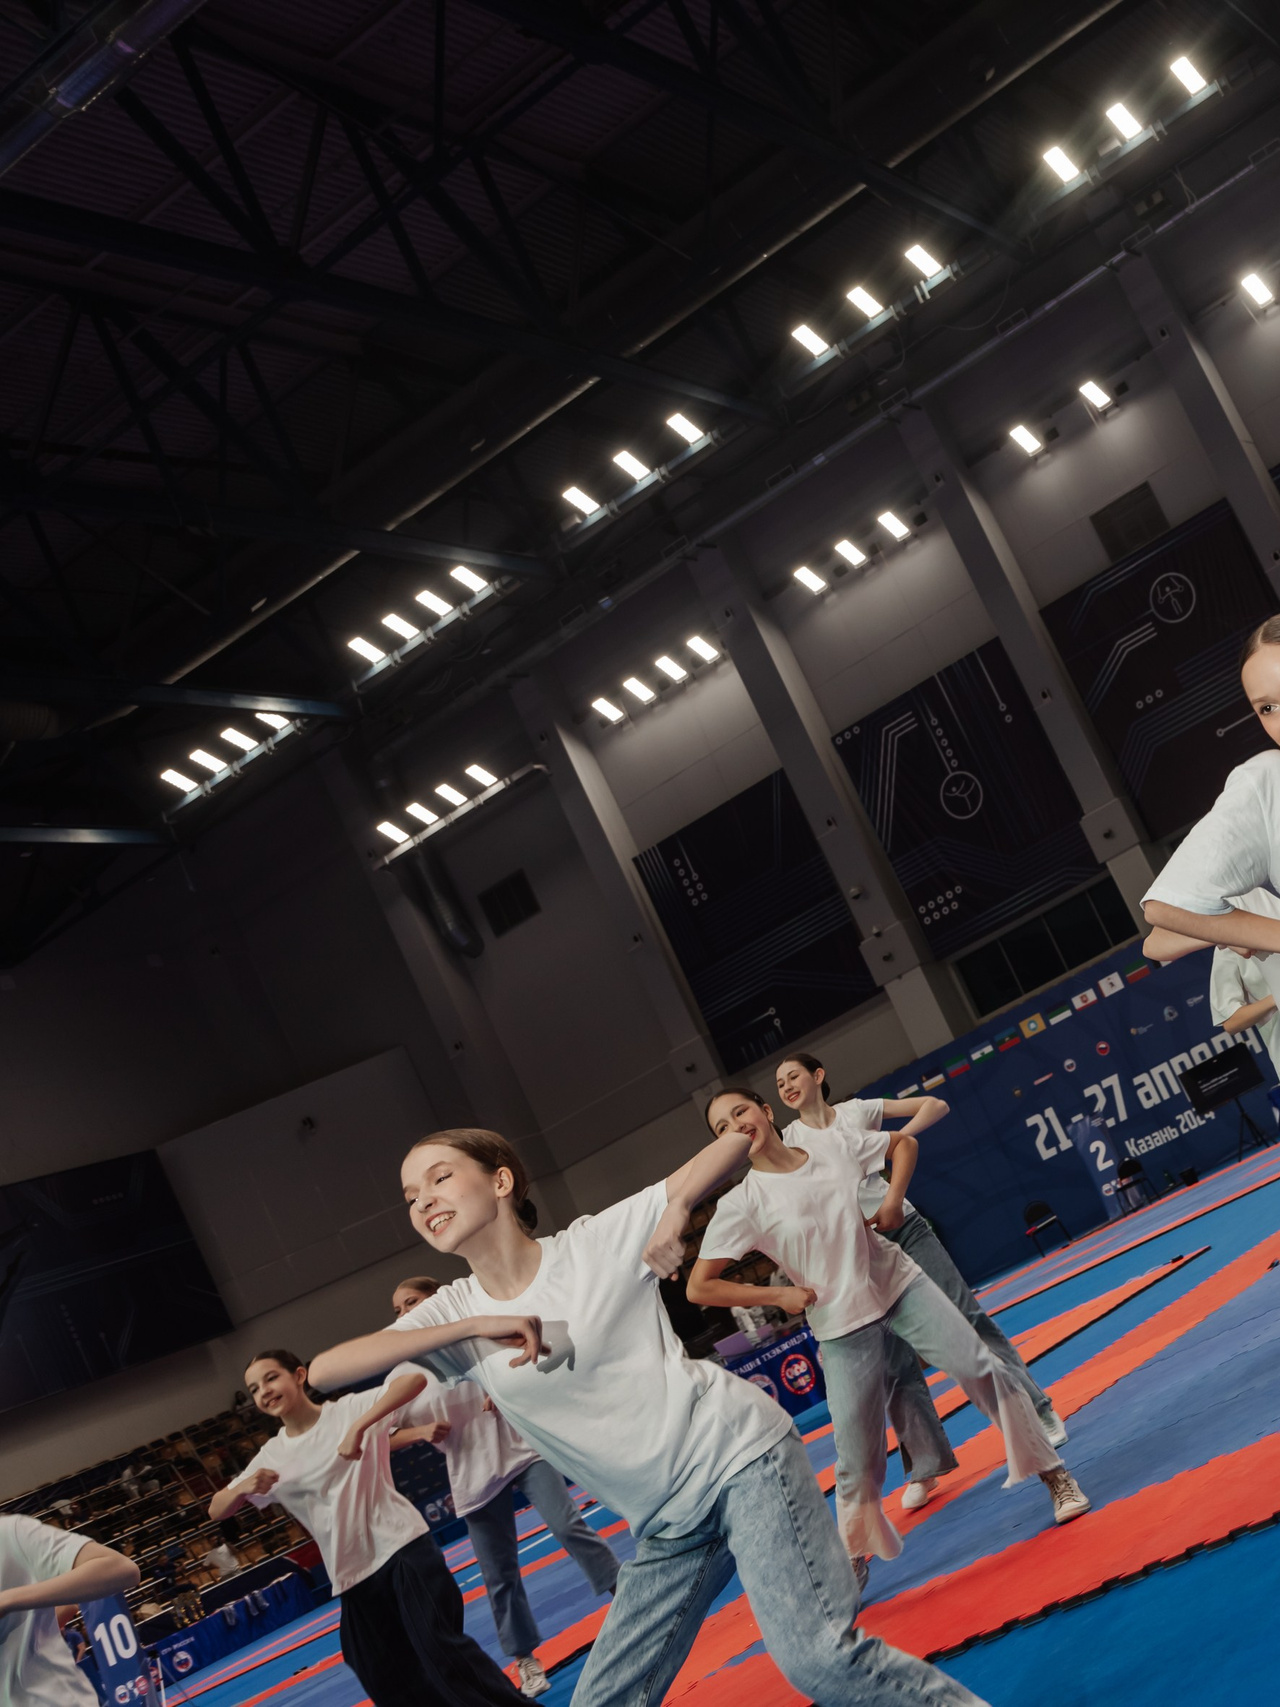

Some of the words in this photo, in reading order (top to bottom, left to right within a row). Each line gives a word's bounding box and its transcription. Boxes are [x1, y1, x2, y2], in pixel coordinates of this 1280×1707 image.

[1025, 1106, 1074, 1161] 21
[1083, 1073, 1128, 1128] 27
[1089, 1140, 1115, 1172] 2
[1124, 1126, 1180, 1158] Казань
[93, 1613, 138, 1667] 10
